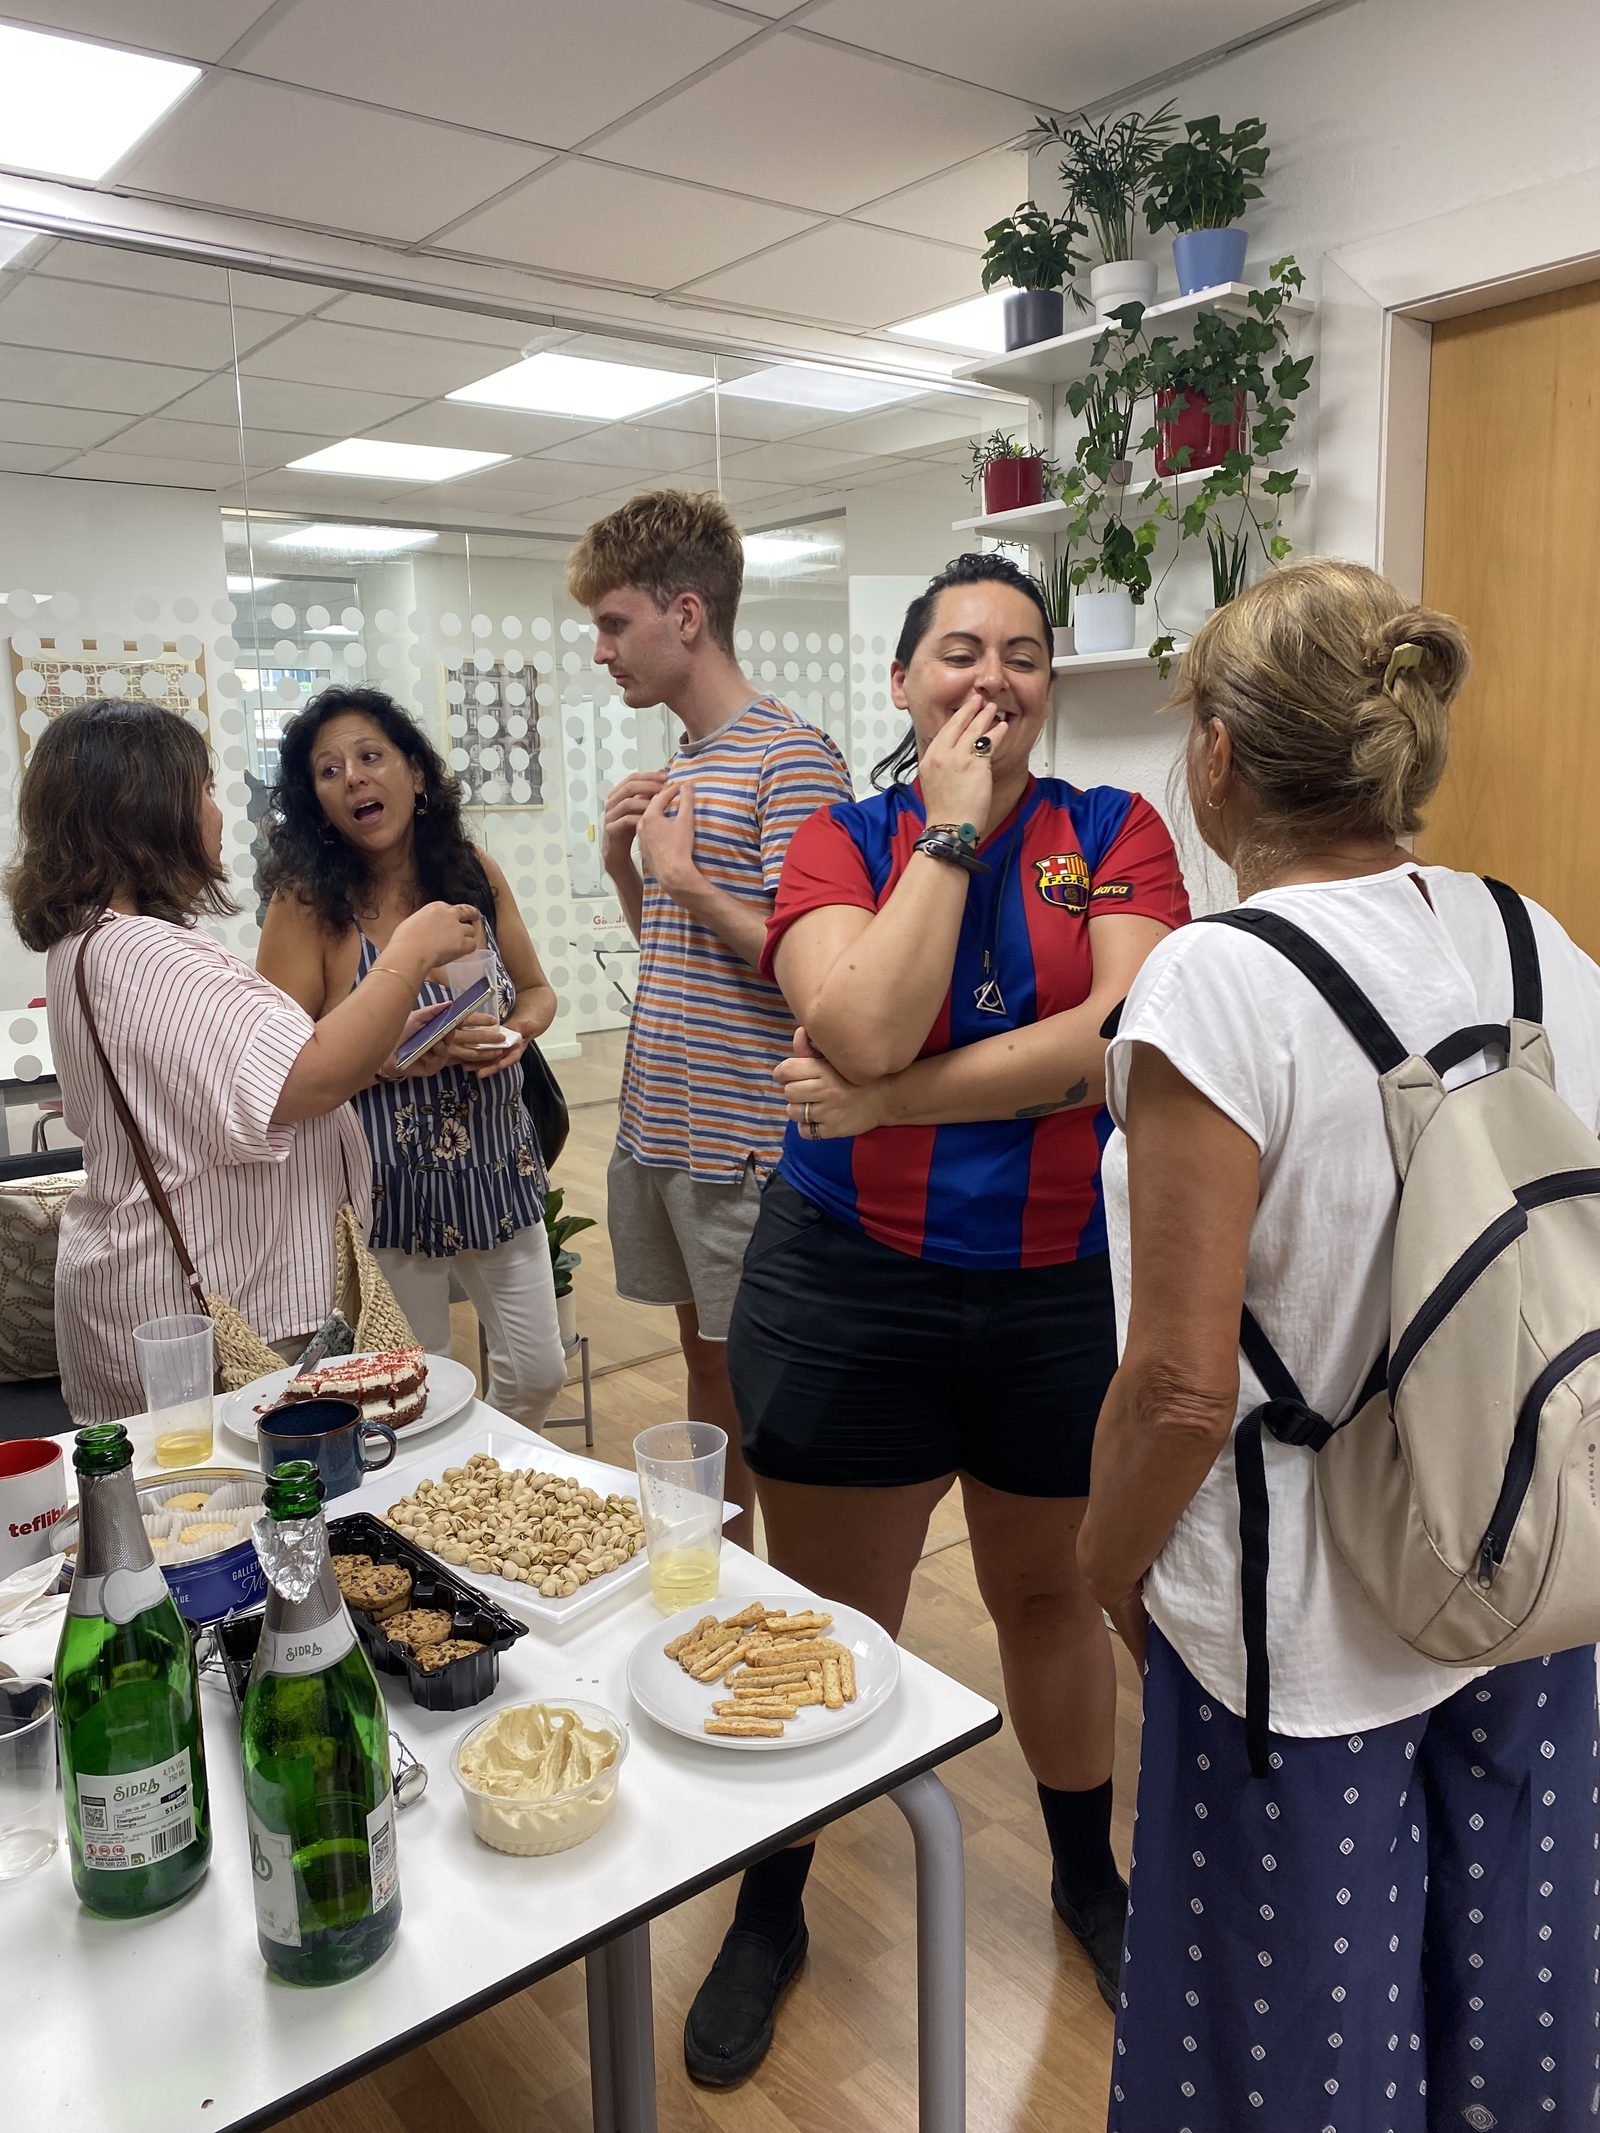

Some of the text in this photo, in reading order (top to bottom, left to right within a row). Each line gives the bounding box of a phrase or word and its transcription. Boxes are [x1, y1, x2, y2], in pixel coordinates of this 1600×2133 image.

[1048, 875, 1087, 887] F.C.B.
[285, 1642, 323, 1661] SIDRA
[113, 1778, 160, 1801] SIDRA
[165, 1797, 187, 1815] 51 kcal
